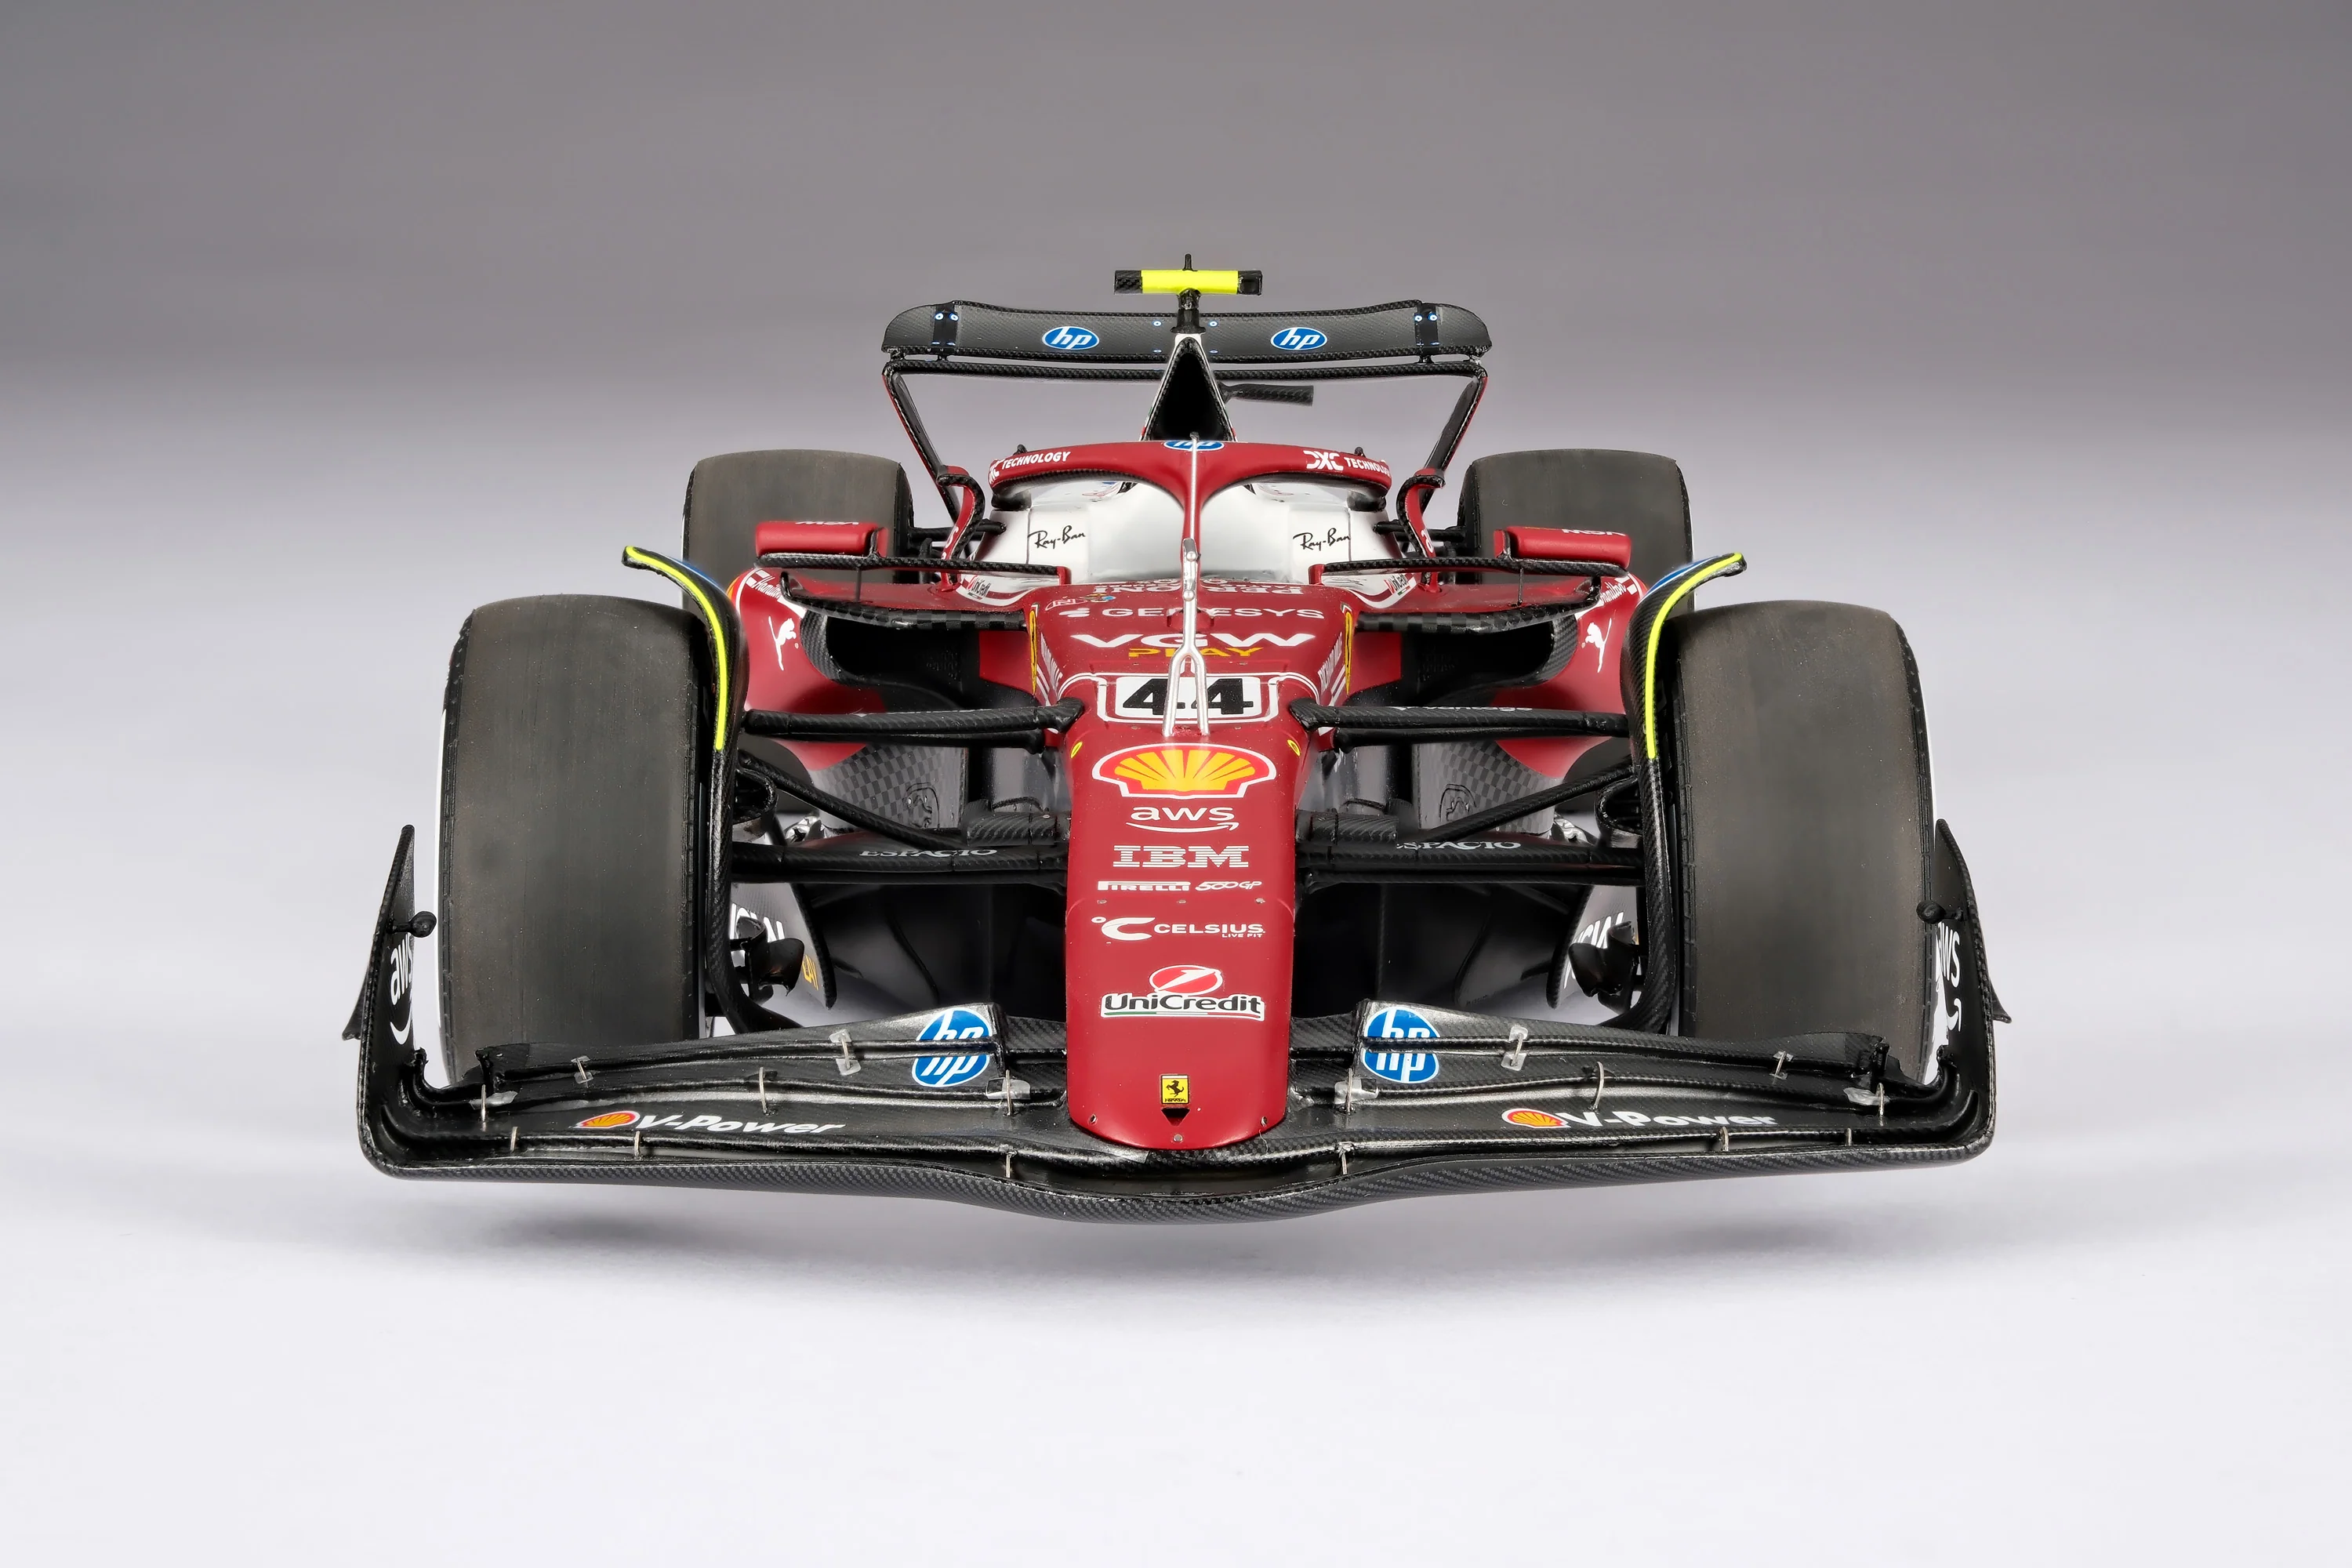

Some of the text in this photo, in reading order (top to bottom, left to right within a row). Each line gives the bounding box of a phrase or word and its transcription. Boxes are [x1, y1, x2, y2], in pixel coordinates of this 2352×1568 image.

[1051, 326, 1093, 350] hp
[1279, 327, 1320, 350] hp
[1002, 452, 1071, 470] TECHNOLOGY
[1303, 450, 1390, 477] DXC TECHNOLO
[1028, 524, 1086, 550] Ray-Ban
[1293, 527, 1350, 551] Ray-Ban
[1102, 608, 1325, 619] GEESYS
[1070, 633, 1316, 648] VGW
[1122, 677, 1254, 716] 44
[1130, 807, 1236, 821] aws
[858, 848, 998, 858] ESPACIO
[1112, 845, 1250, 868] IBM
[1098, 880, 1191, 891] PIRELLI
[1105, 993, 1261, 1014] UniCredit
[920, 1009, 985, 1086] hp
[1376, 1007, 1431, 1083] hp
[636, 1114, 847, 1134] V-Power
[1555, 1111, 1779, 1127] V-Power
